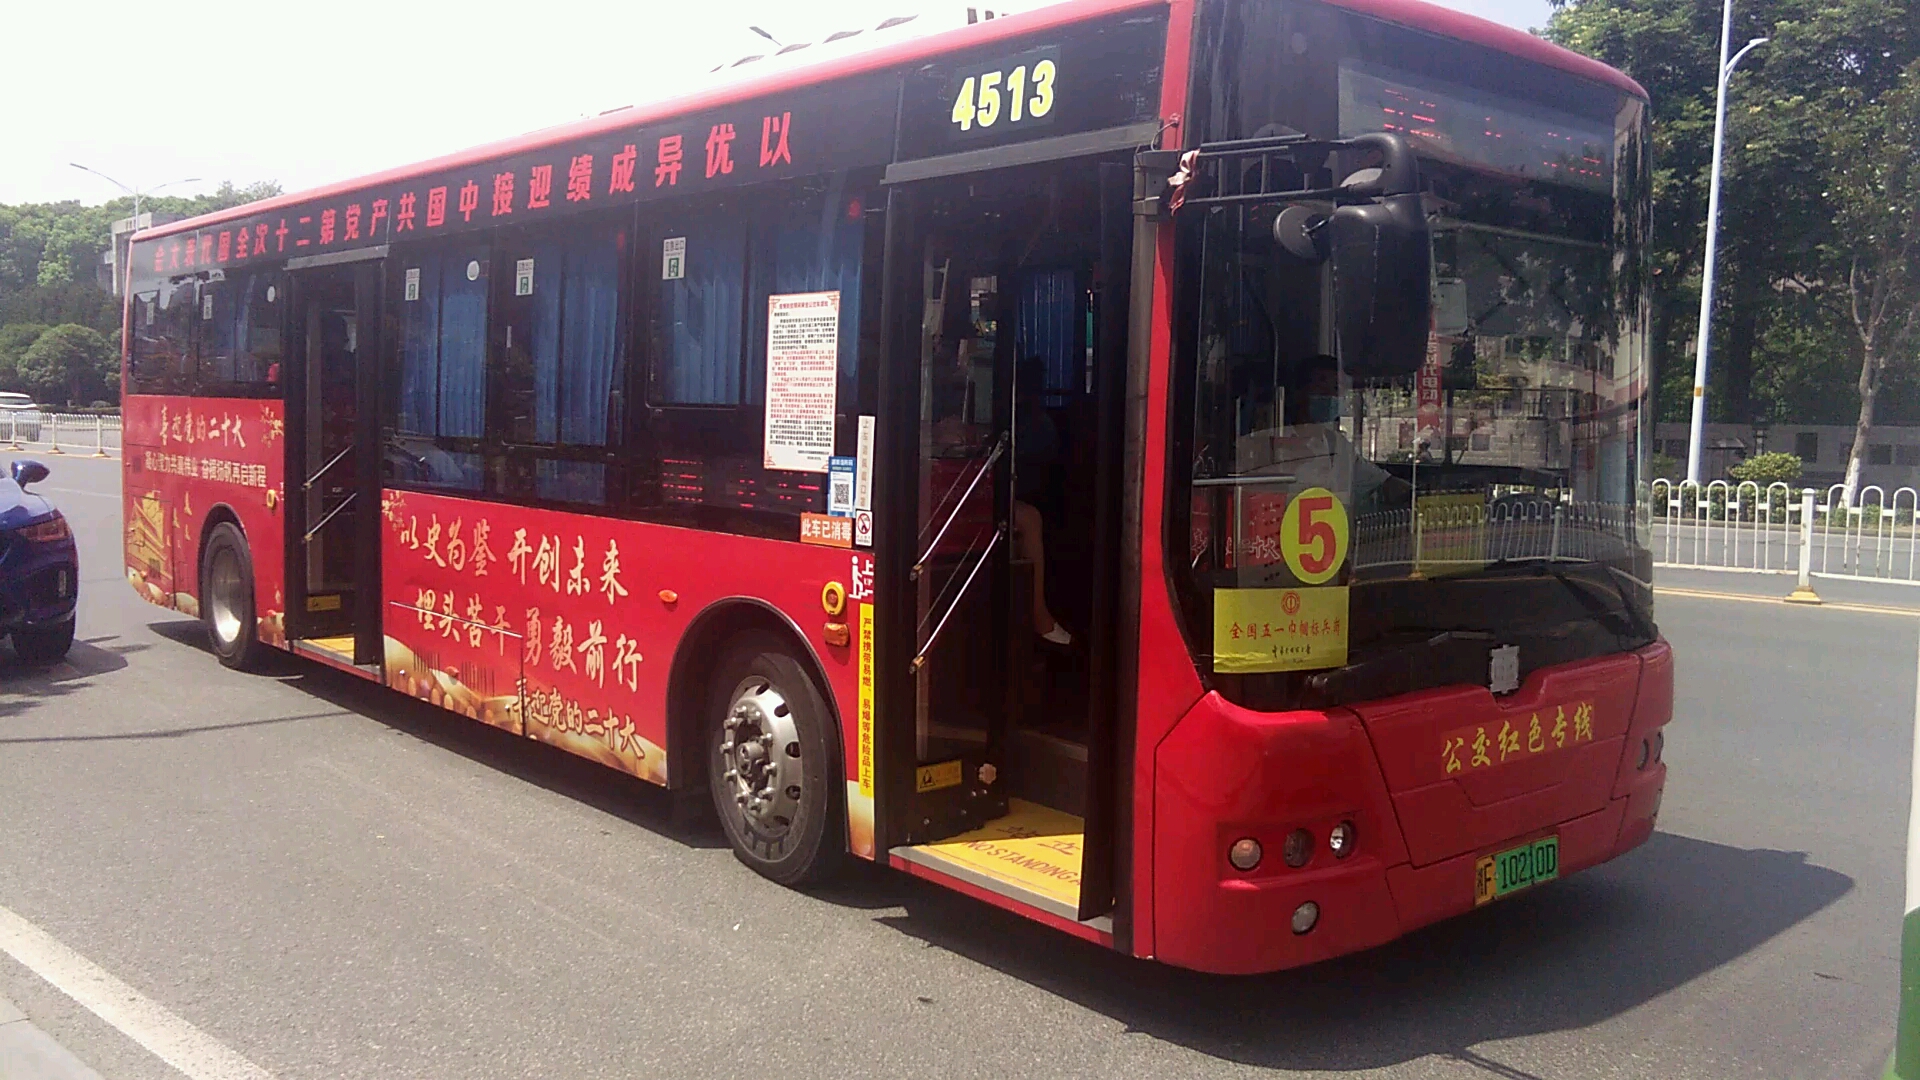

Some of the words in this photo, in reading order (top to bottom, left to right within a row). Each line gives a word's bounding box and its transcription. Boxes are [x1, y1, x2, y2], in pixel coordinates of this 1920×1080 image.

[952, 59, 1056, 131] 4513
[159, 404, 246, 448] 喜迎党的二十大
[401, 514, 497, 577] 以史为鉴
[507, 528, 628, 605] 开创未来
[802, 518, 852, 541] 此车已消毒
[1298, 496, 1337, 574] 5
[415, 588, 511, 657] 埋头苦干
[523, 607, 643, 692] 勇毅前行
[1441, 701, 1594, 774] 公交红色专线
[987, 845, 1078, 881] STANDING
